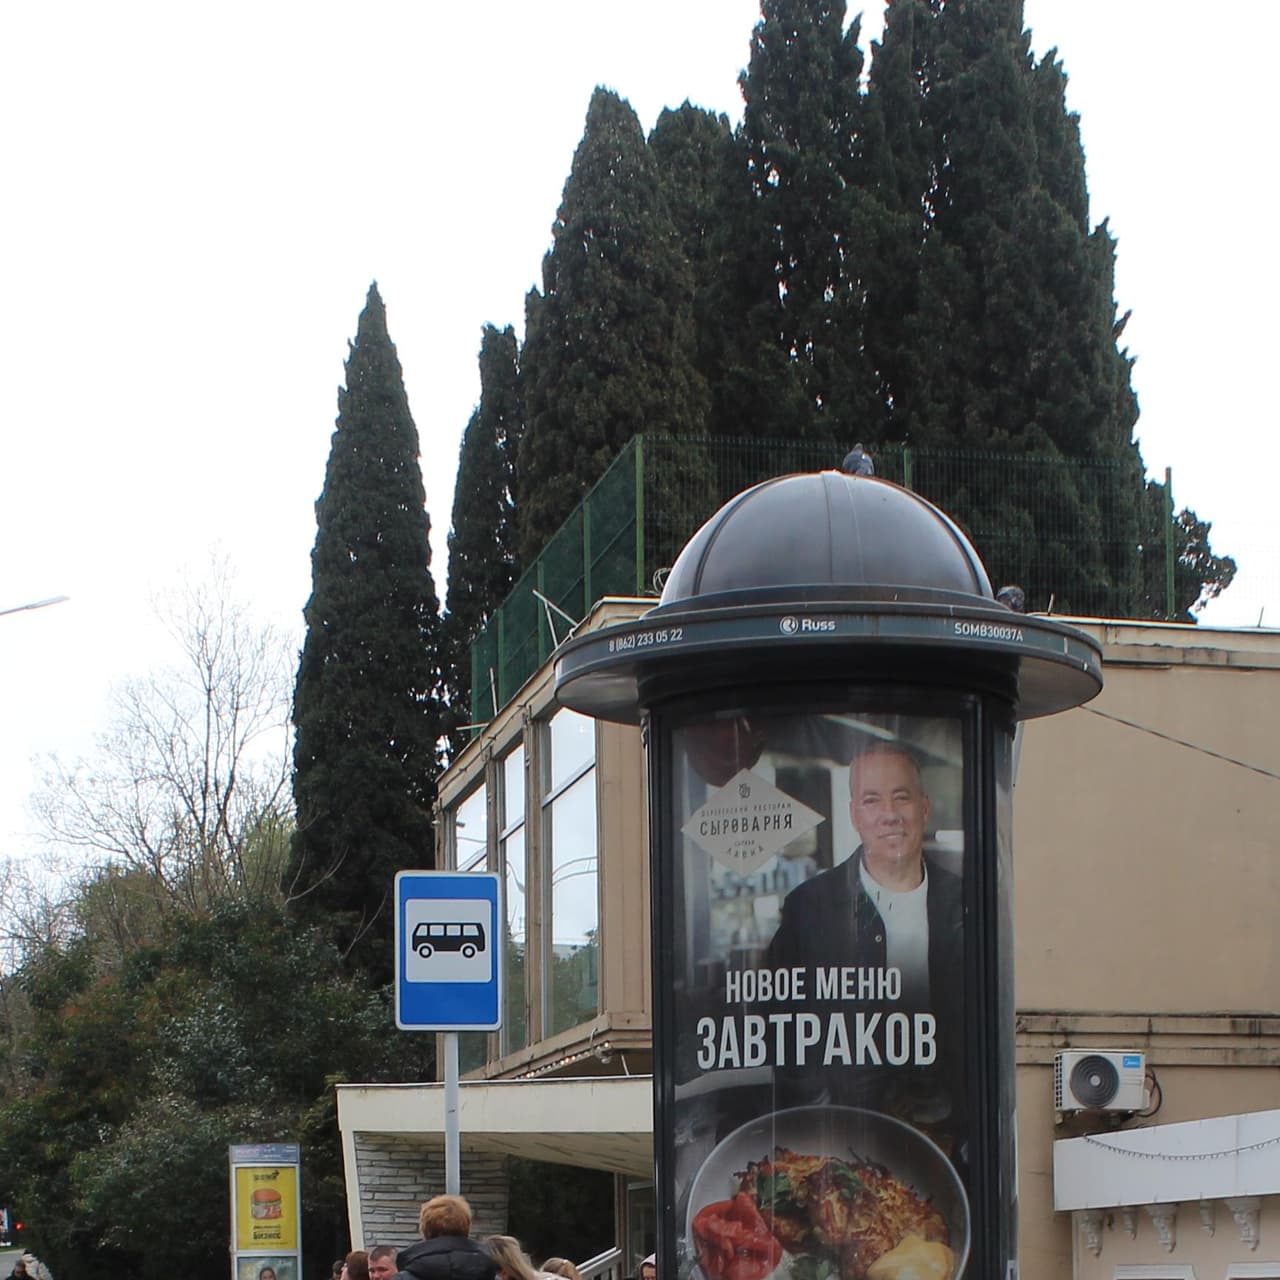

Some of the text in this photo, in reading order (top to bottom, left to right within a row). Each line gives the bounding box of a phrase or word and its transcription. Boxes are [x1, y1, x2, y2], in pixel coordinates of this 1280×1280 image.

[801, 618, 836, 632] Russ
[616, 636, 635, 651] (862)
[637, 633, 654, 646] 233
[656, 630, 668, 643] 05
[670, 628, 683, 641] 22
[700, 813, 792, 836] СЫРОВАРНЯ
[726, 967, 902, 1003] НОВОЕ МЕНЮ
[696, 1012, 937, 1070] ЗАВТРАКОВ
